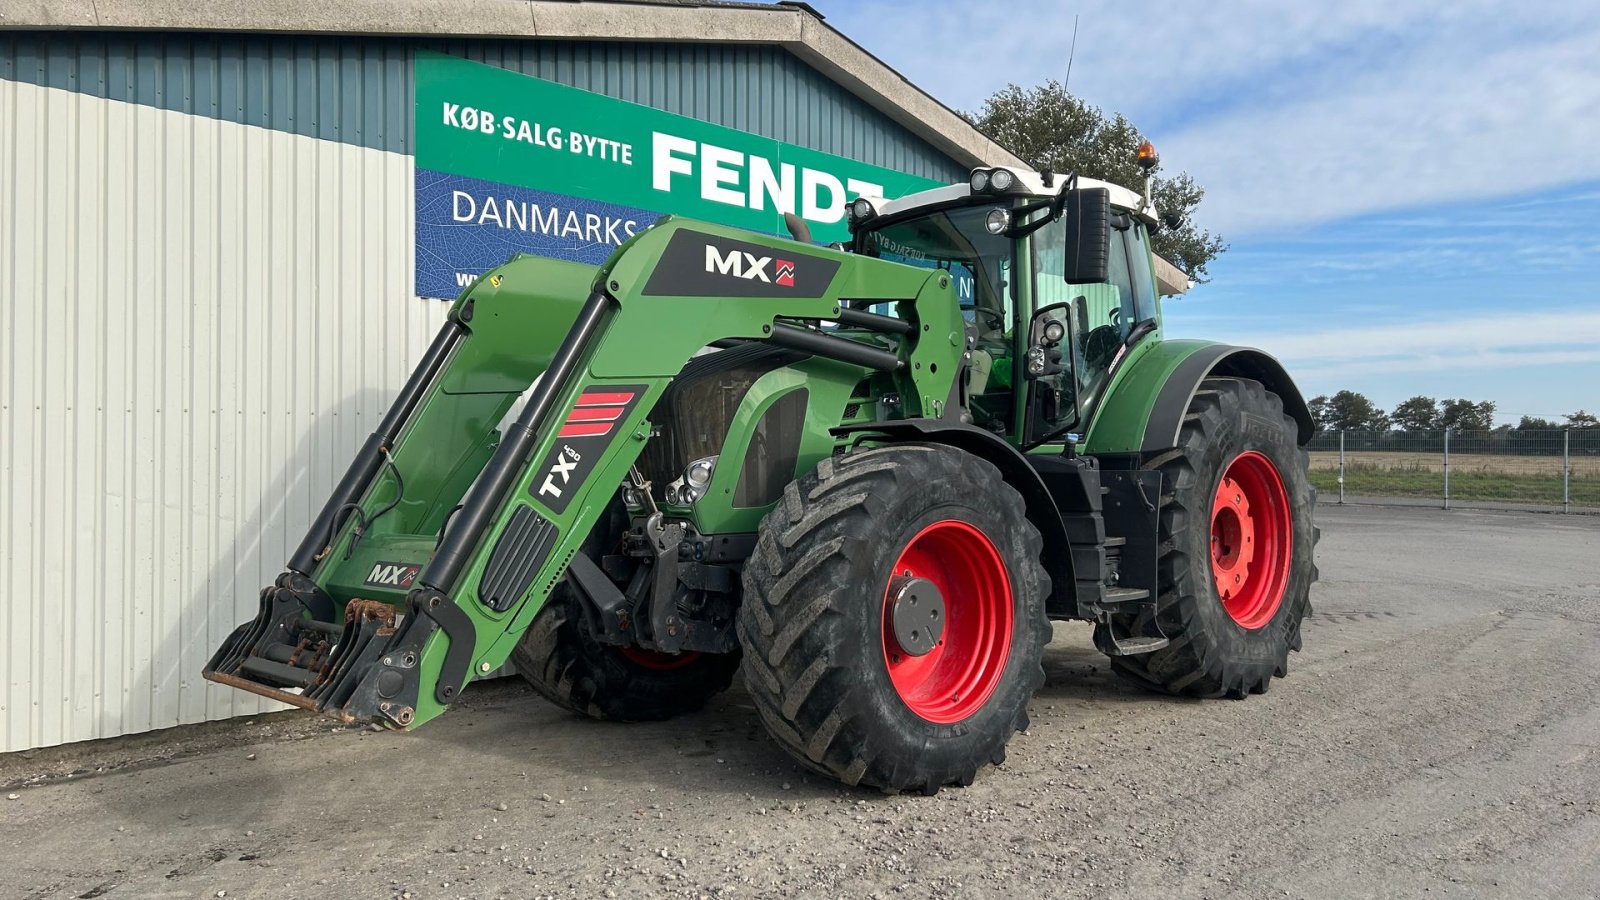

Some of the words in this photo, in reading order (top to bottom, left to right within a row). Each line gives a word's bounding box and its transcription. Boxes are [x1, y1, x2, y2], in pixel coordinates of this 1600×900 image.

[452, 190, 637, 246] DANMARKS
[705, 244, 773, 284] MX
[366, 564, 408, 585] MX
